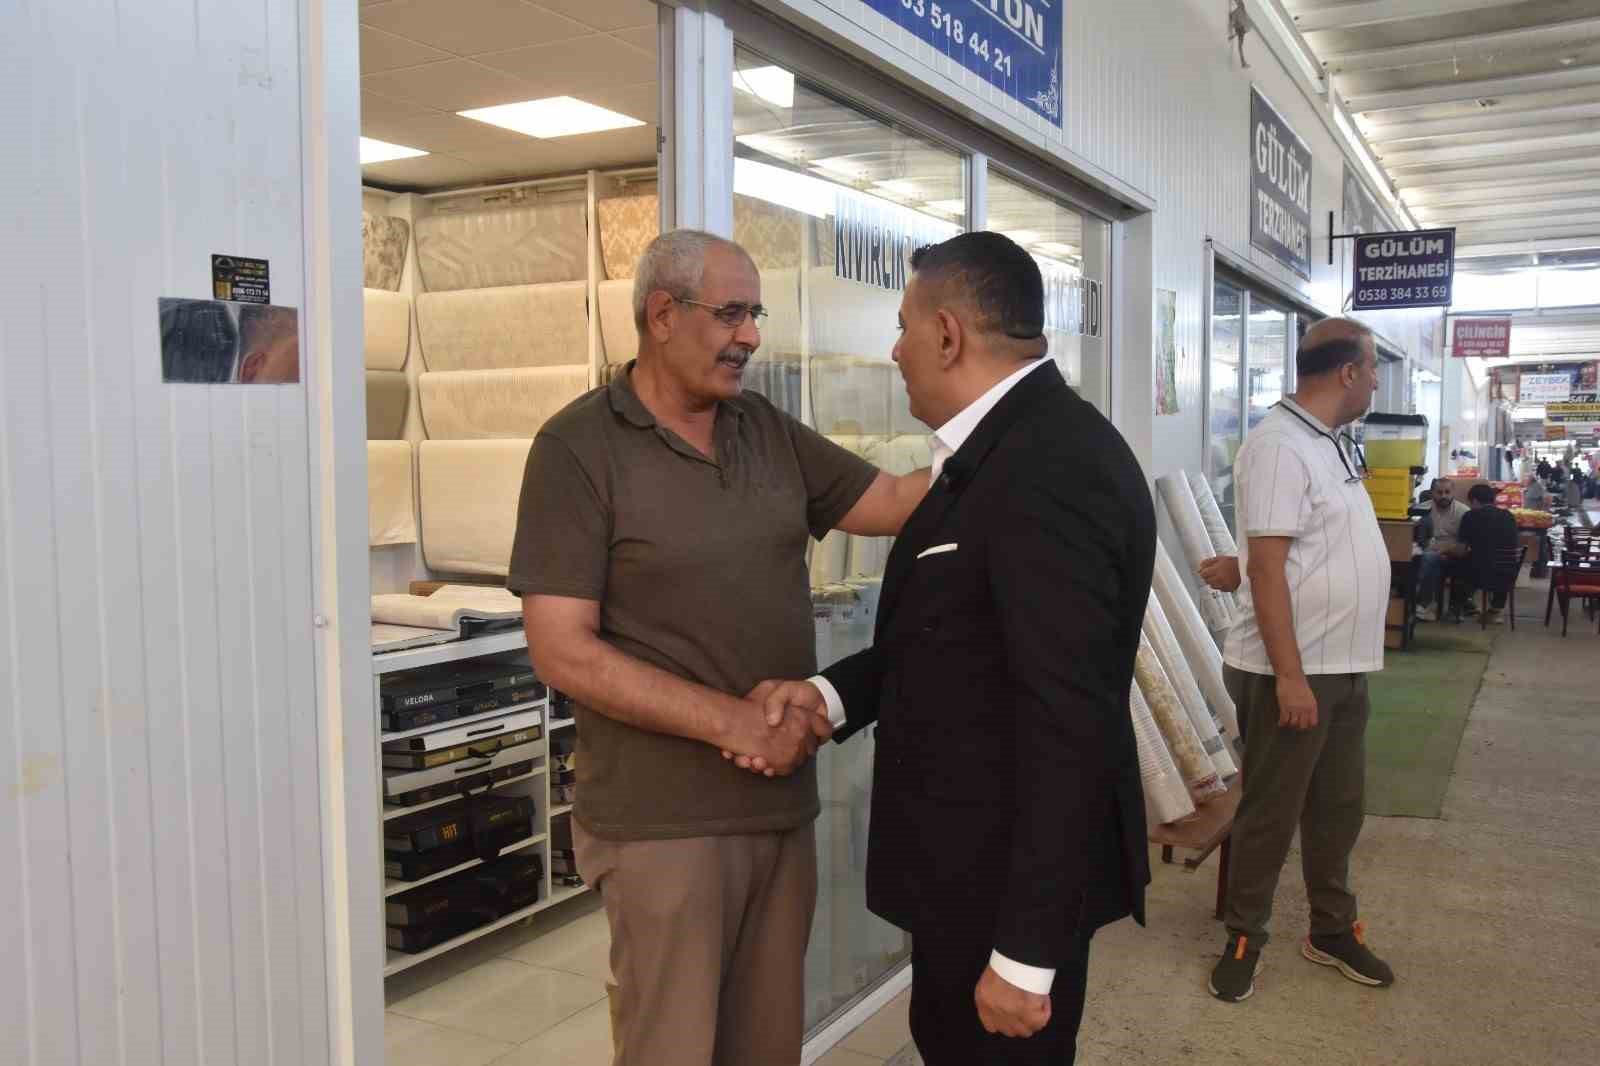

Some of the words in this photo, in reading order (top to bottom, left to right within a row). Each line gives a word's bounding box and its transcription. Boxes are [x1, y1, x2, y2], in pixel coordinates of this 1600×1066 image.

[990, 0, 1043, 47] ON
[930, 3, 964, 44] 518
[969, 32, 989, 61] 44
[994, 48, 1011, 77] 21
[1255, 121, 1309, 214] GÜLÜM
[1365, 237, 1445, 258] GÜLÜM
[1359, 259, 1450, 282] TERZİHANESİ
[1358, 288, 1388, 302] 0538
[1390, 287, 1412, 300] 384
[1415, 286, 1430, 299] 33
[1432, 285, 1447, 298] 69
[404, 694, 434, 705] VELORA
